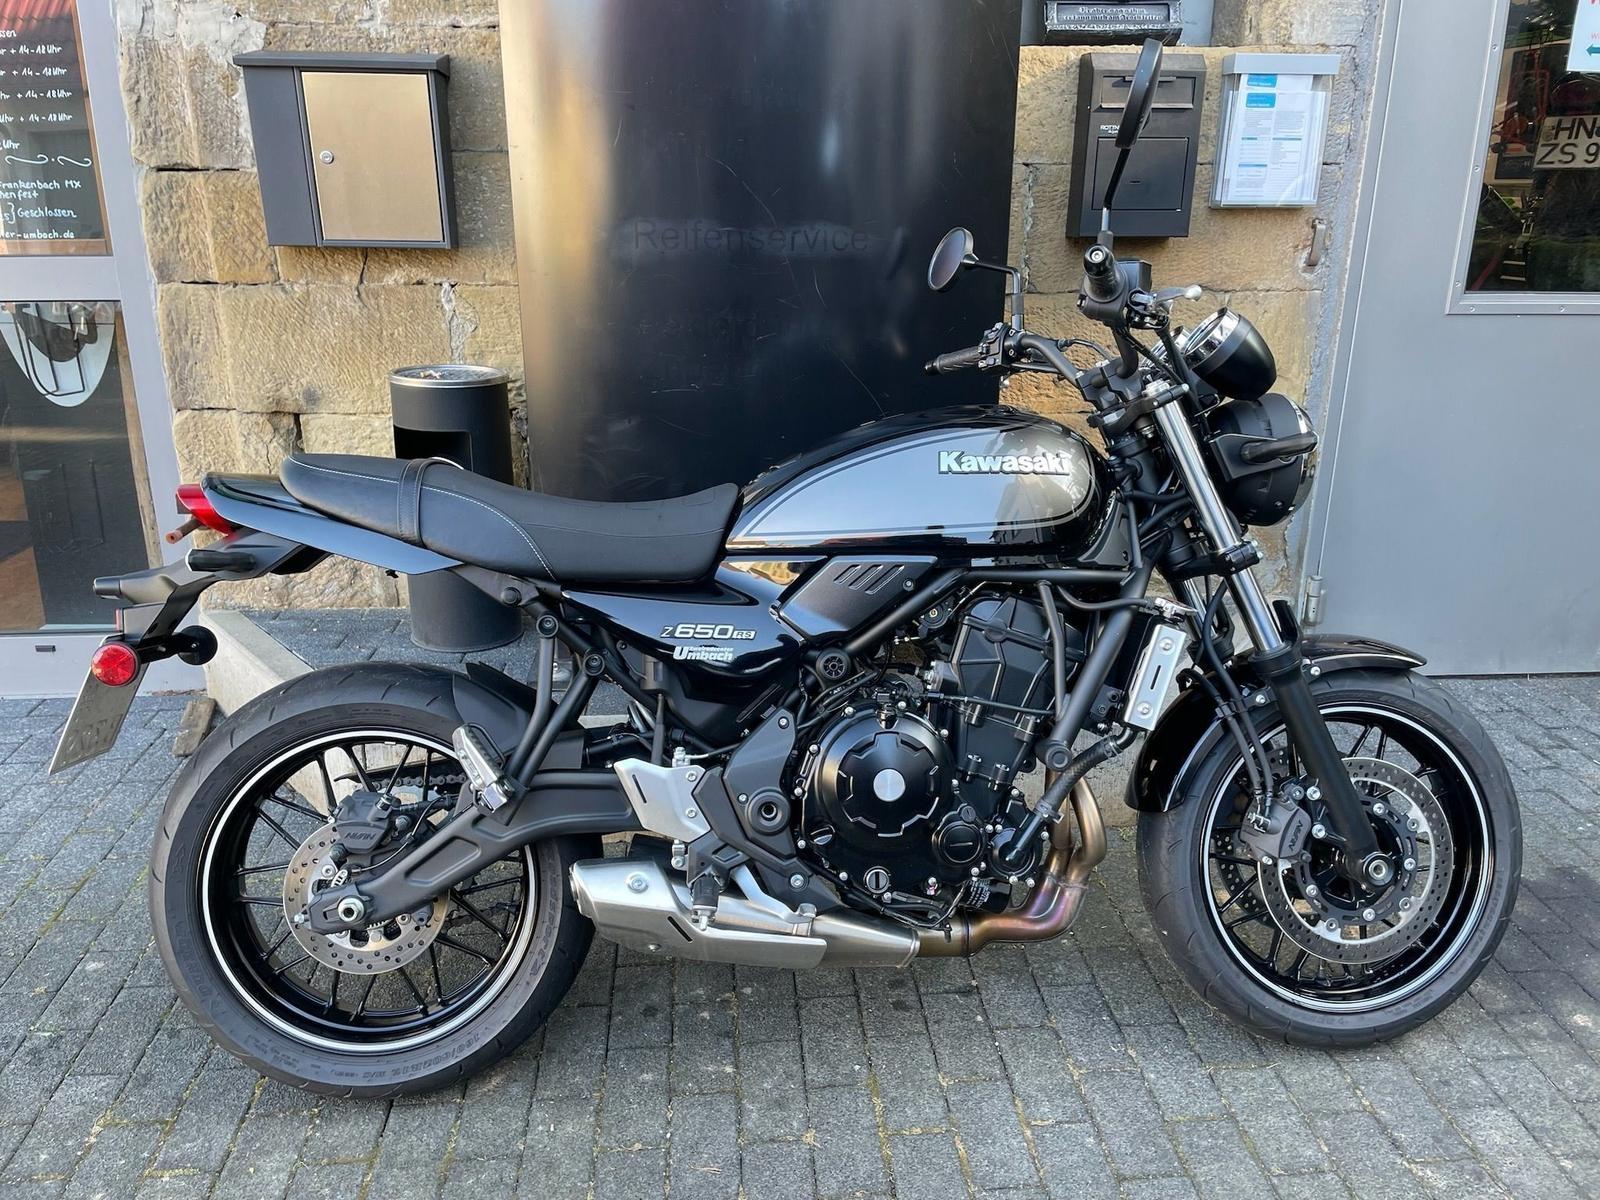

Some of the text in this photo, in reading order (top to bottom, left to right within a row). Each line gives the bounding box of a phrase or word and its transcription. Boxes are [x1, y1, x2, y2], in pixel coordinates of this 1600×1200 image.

[1536, 143, 1578, 165] ZS
[634, 219, 868, 251] Reifenservice
[938, 450, 1071, 475] Kawasaki
[673, 646, 733, 660] Umbach
